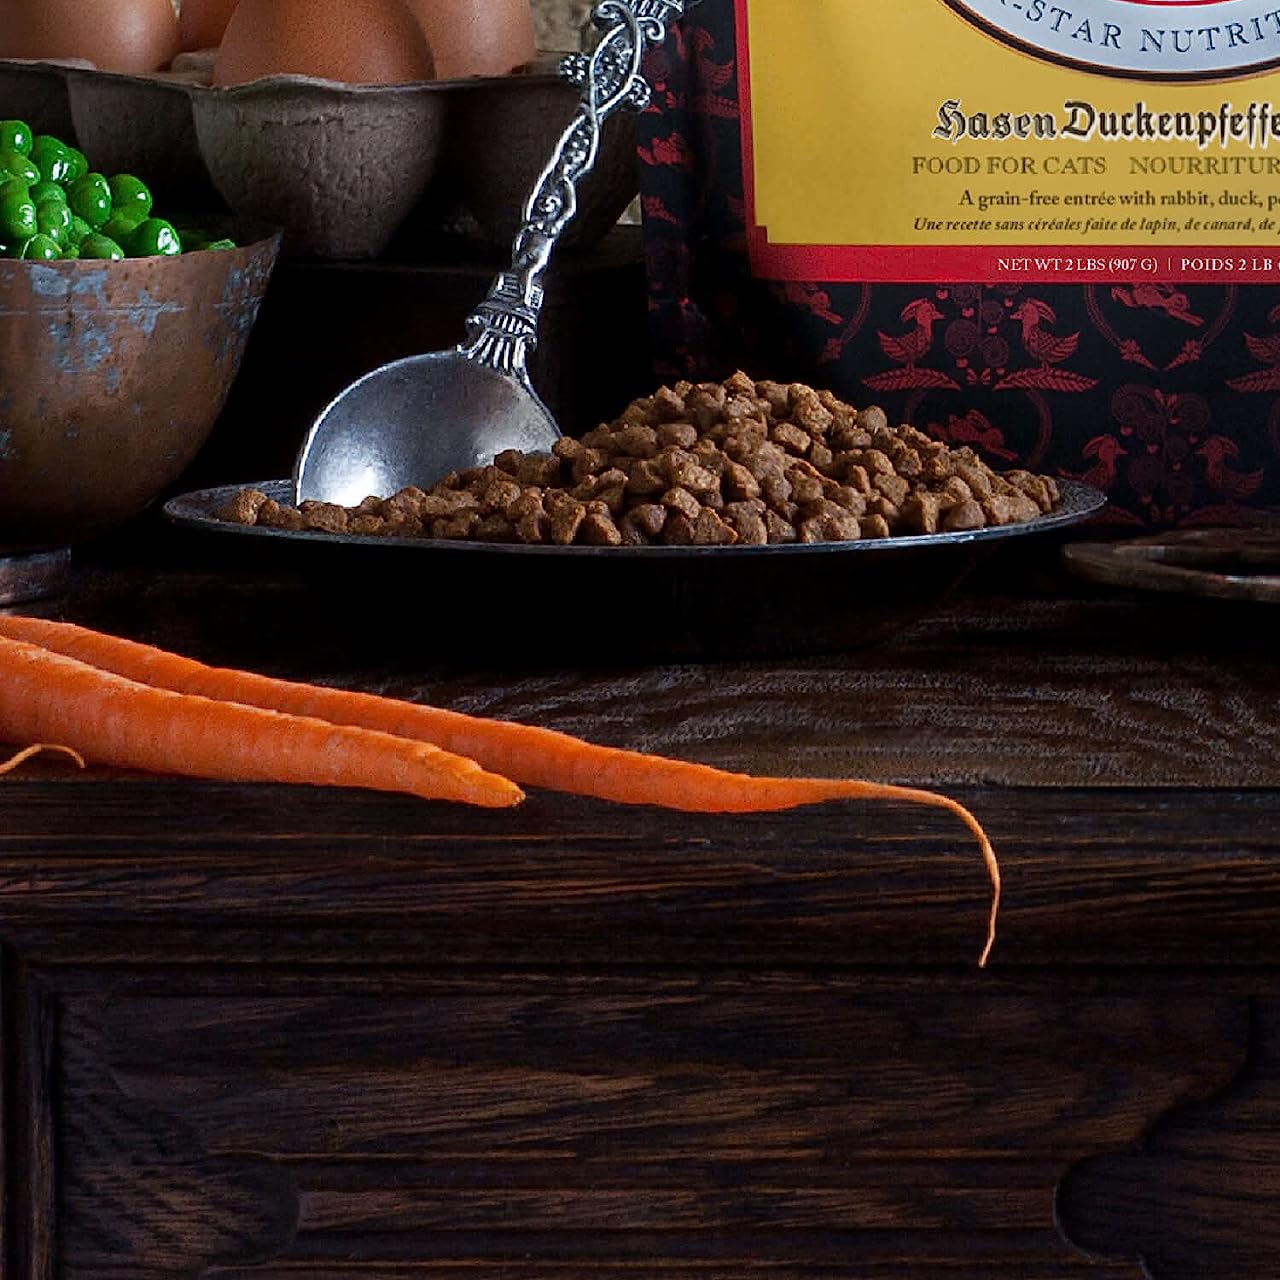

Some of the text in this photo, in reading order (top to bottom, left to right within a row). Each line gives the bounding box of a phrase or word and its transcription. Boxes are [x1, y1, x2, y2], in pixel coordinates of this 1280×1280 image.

[933, 99, 1055, 144] Hasen
[912, 157, 980, 174] FOOD
[987, 157, 1037, 174] FOR
[1043, 157, 1107, 174] CATS
[958, 190, 973, 205] A
[978, 190, 1060, 211] grain-free
[1064, 192, 1115, 205] entrée
[1119, 190, 1156, 205] with
[1161, 190, 1215, 208] rabbit,
[1218, 190, 1263, 208] duck,
[914, 218, 944, 231] Une
[947, 218, 992, 231] recette
[995, 221, 1024, 231] sans
[1027, 218, 1081, 231] céréales
[1083, 218, 1118, 234] faite
[1120, 218, 1137, 231] de
[1140, 218, 1181, 235] lapin,
[1184, 218, 1201, 231] de
[1203, 218, 1255, 234] canard,
[1258, 218, 1275, 231] de
[998, 258, 1032, 270] NET
[1034, 258, 1062, 270] WT
[1064, 258, 1073, 270] 2
[1076, 258, 1106, 270] LBS
[1108, 258, 1137, 272] (907
[1140, 258, 1158, 272] G)
[1181, 258, 1234, 271] POIDS
[1238, 258, 1247, 271] 2
[1252, 258, 1272, 271] LB
